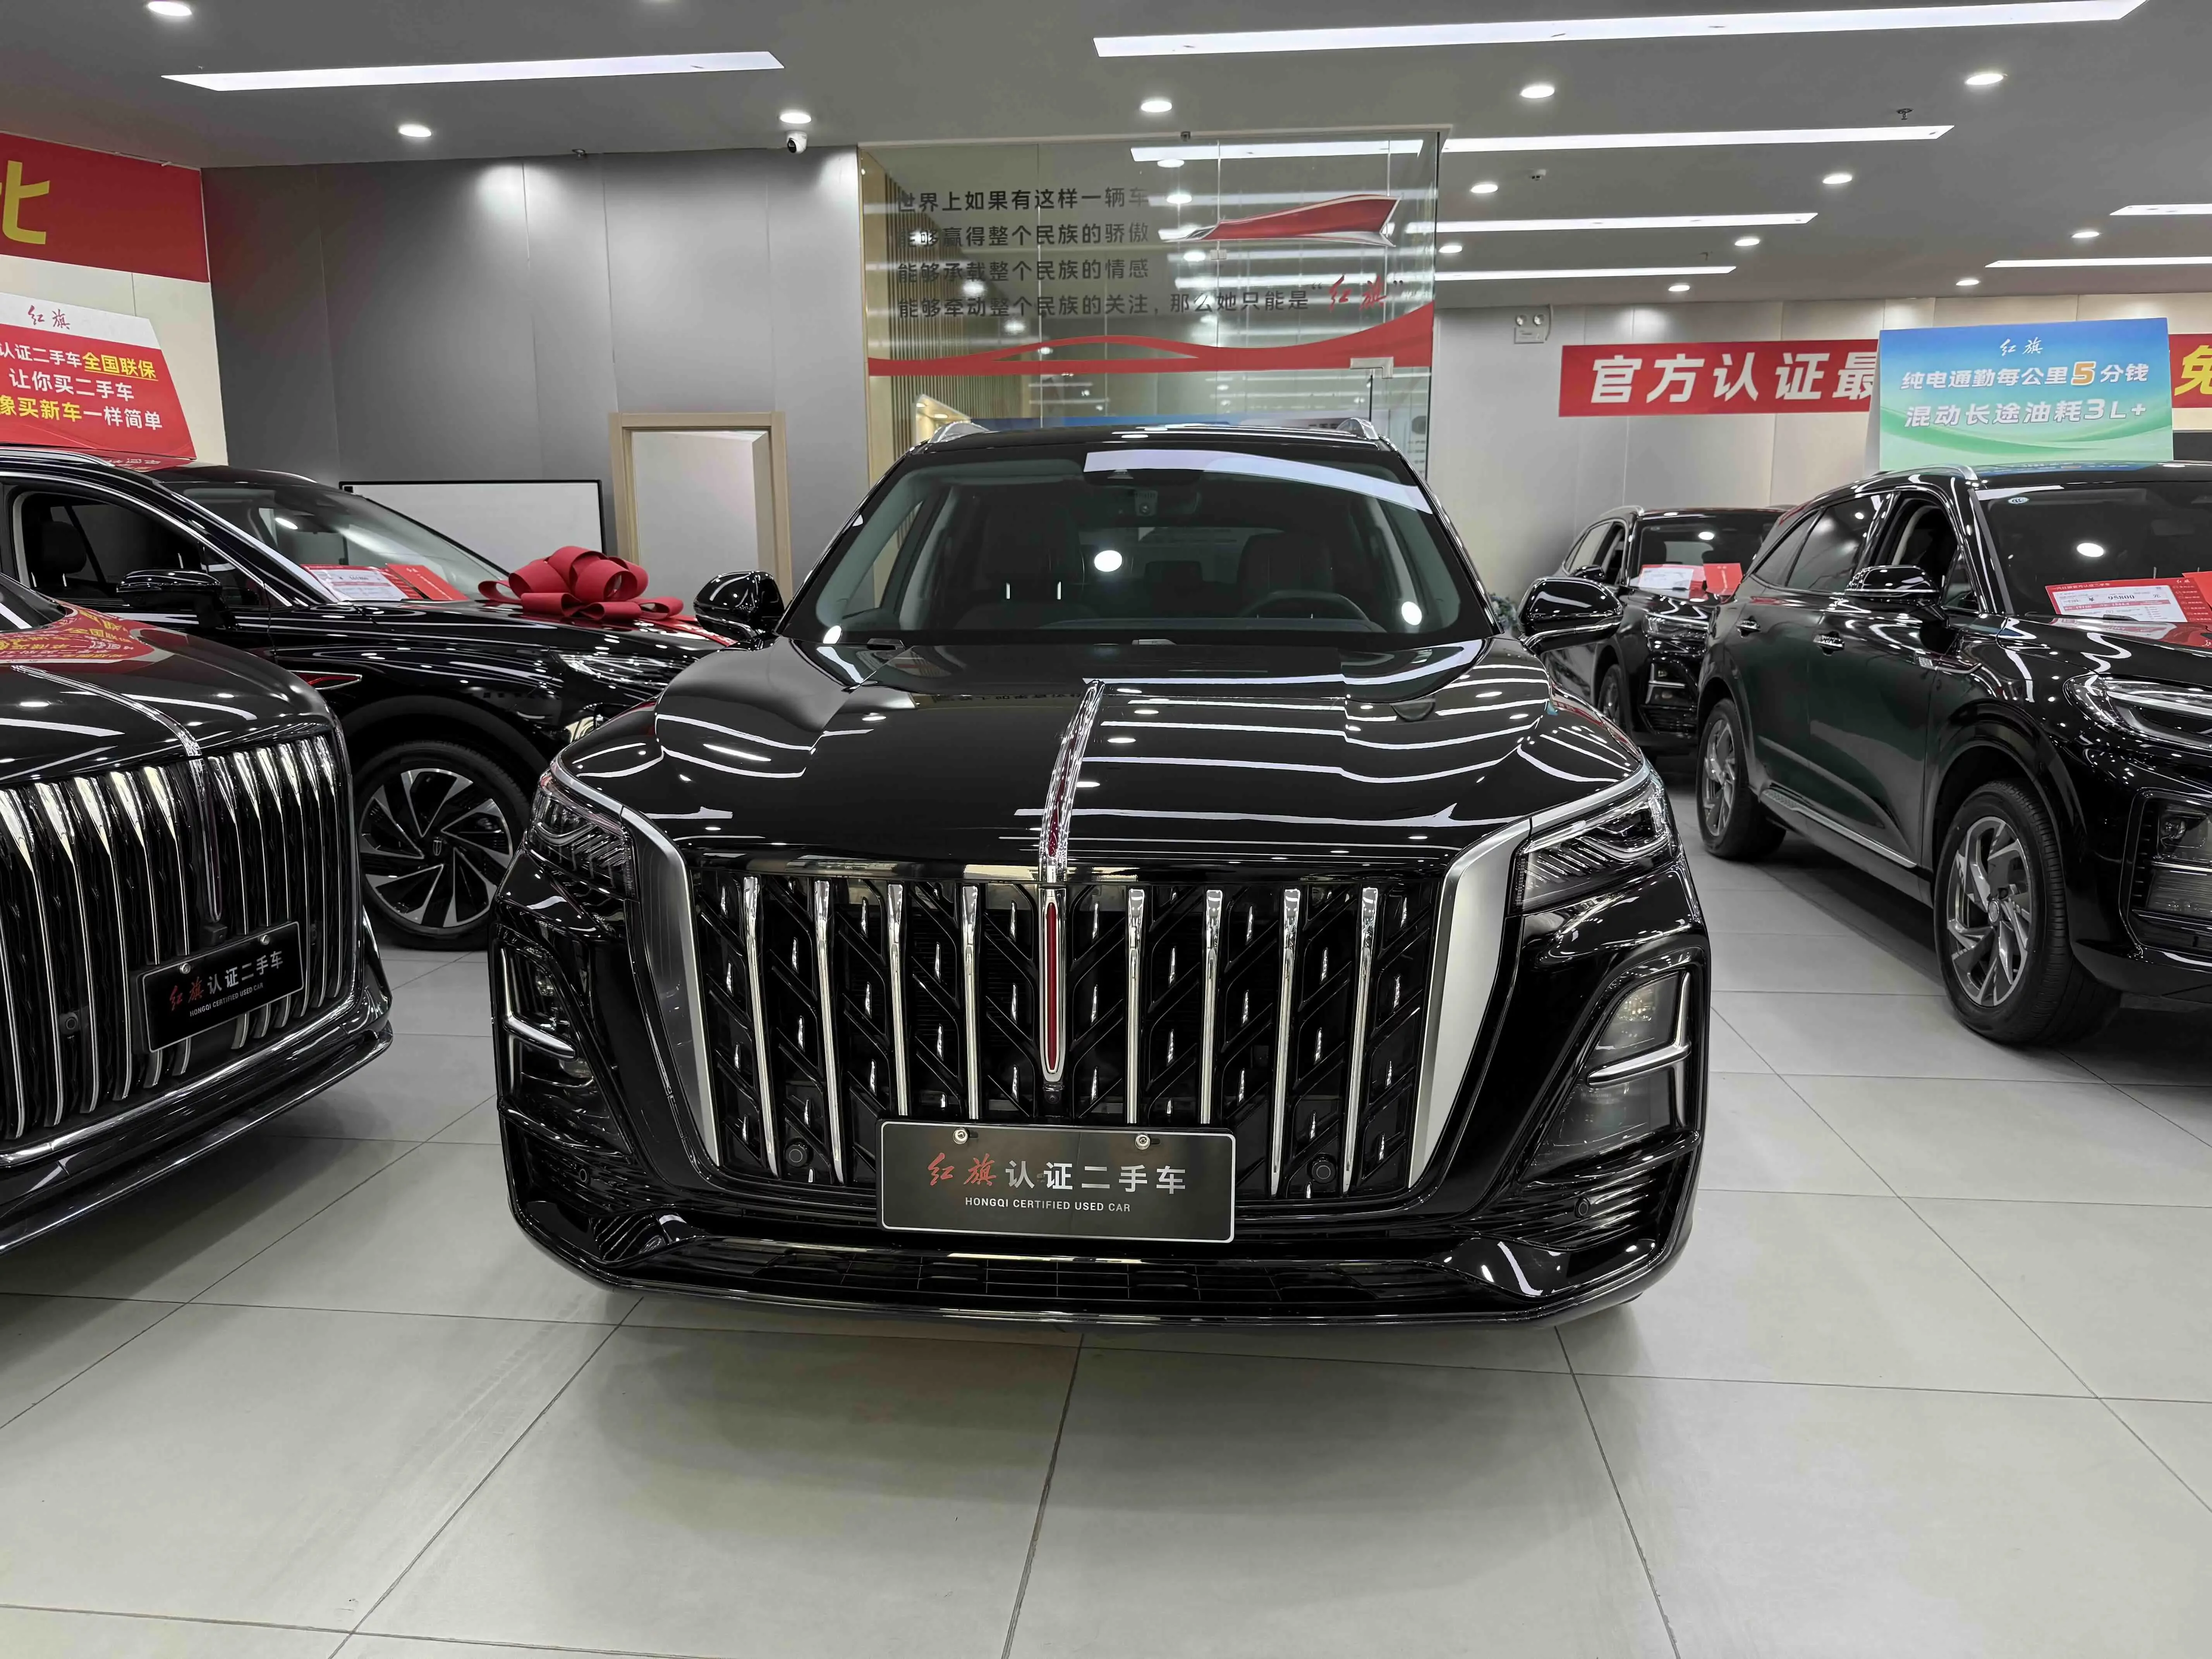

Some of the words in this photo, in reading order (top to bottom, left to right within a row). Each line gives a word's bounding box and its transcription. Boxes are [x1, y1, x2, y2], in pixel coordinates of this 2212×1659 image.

[898, 187, 1149, 212] 世界上如果有这样一辆车
[898, 222, 1149, 249] 能够赢得整个民族的骄傲
[898, 258, 1149, 283] 能够承载整个民族的情感
[1999, 337, 2043, 356] 红旗
[9, 368, 134, 402] 让你买二手车
[1591, 352, 1877, 404] 官方认证最
[1900, 361, 2149, 390] 纯电通勤每公里5分钱
[1904, 398, 2146, 428] 混动长途油耗3L+
[169, 951, 283, 1011] 红旗认证二手车
[190, 1004, 211, 1017] HONGQI
[212, 993, 239, 1008] CERTIFIED
[240, 987, 252, 997] USED
[927, 1152, 1186, 1194] 红旗认证二手车
[965, 1197, 1008, 1207] HONGQI
[1013, 1199, 1070, 1210] CERTIFIED
[1074, 1202, 1104, 1211] USED
[1108, 1203, 1131, 1212] CAR
